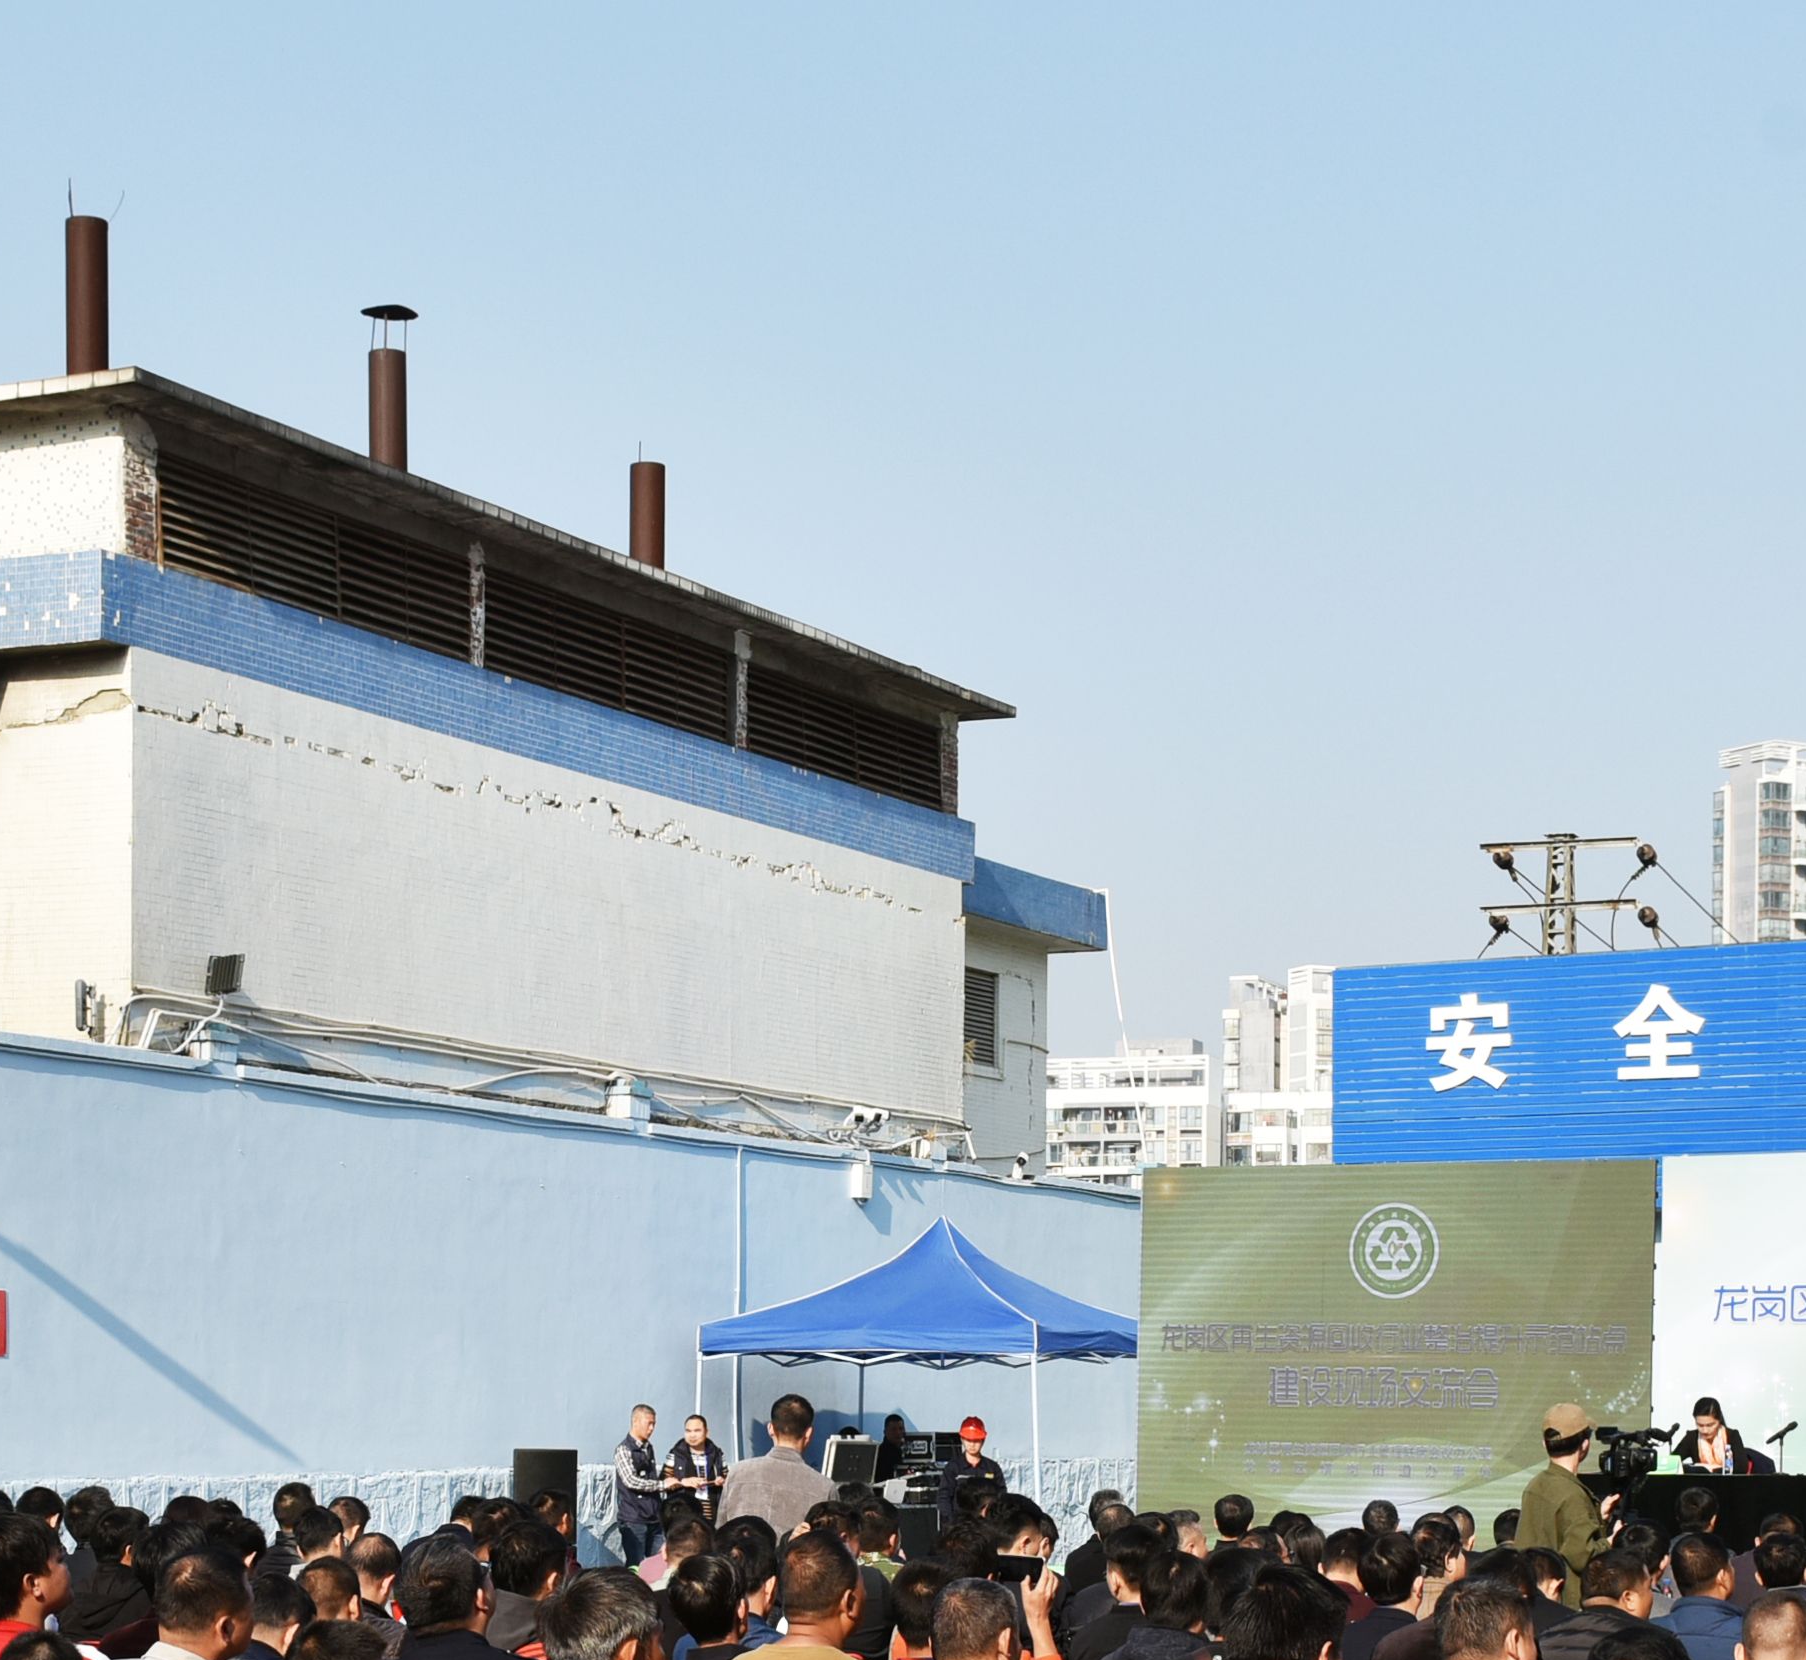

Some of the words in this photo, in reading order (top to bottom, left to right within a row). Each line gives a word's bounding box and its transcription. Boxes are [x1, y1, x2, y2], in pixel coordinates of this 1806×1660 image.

[1267, 1366, 1499, 1408] 建设现场交流会
